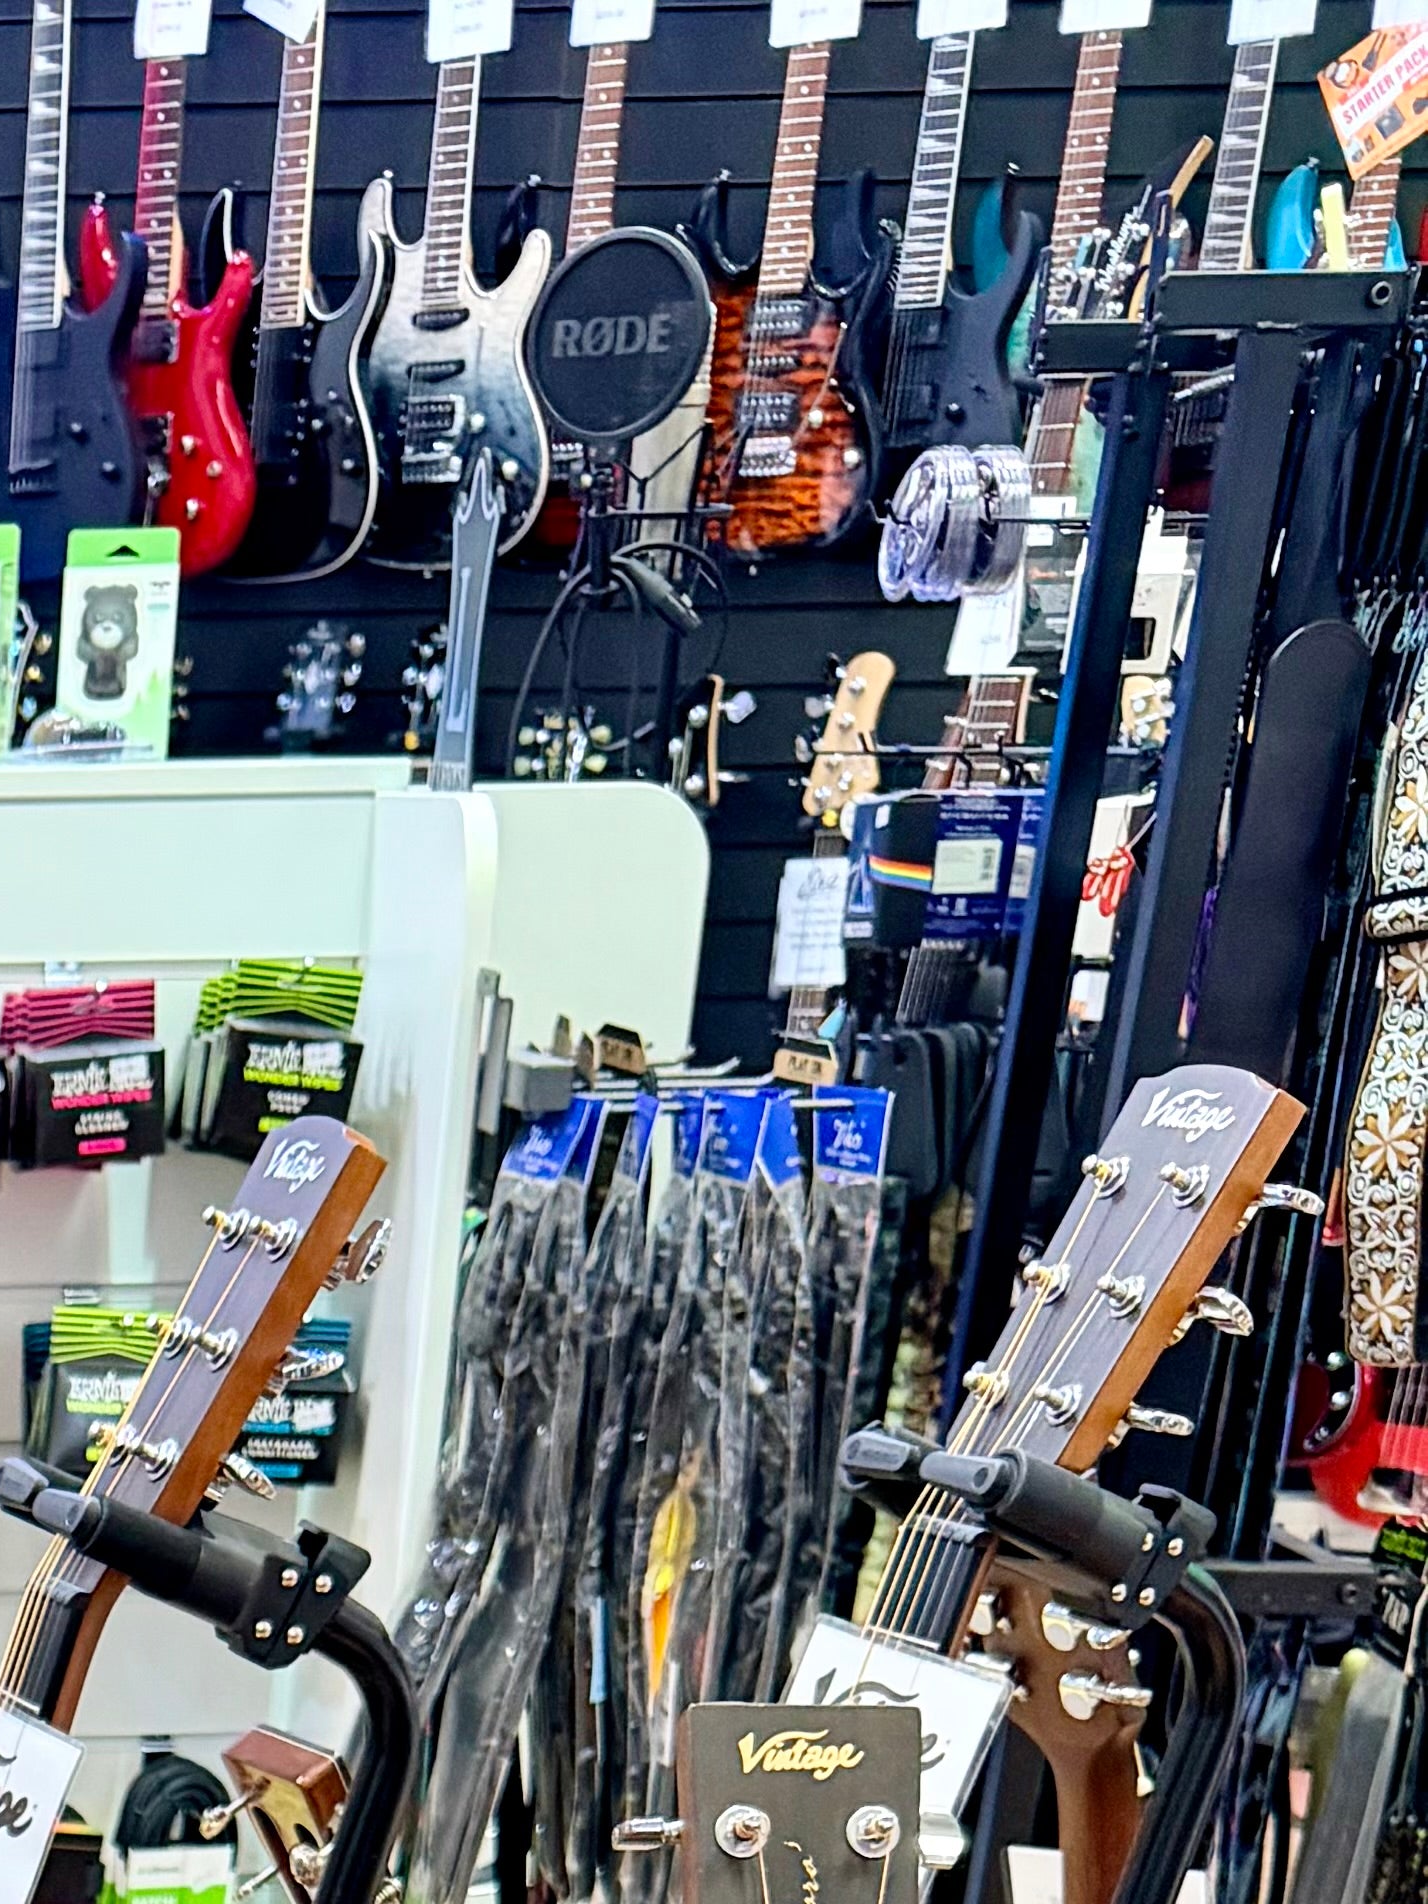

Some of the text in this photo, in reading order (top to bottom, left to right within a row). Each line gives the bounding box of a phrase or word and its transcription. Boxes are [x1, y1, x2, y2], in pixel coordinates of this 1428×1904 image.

[1342, 74, 1395, 124] STARTER
[552, 313, 673, 358] RØDE
[1141, 1087, 1236, 1142] Vintage
[738, 1729, 865, 1781] Vintage
